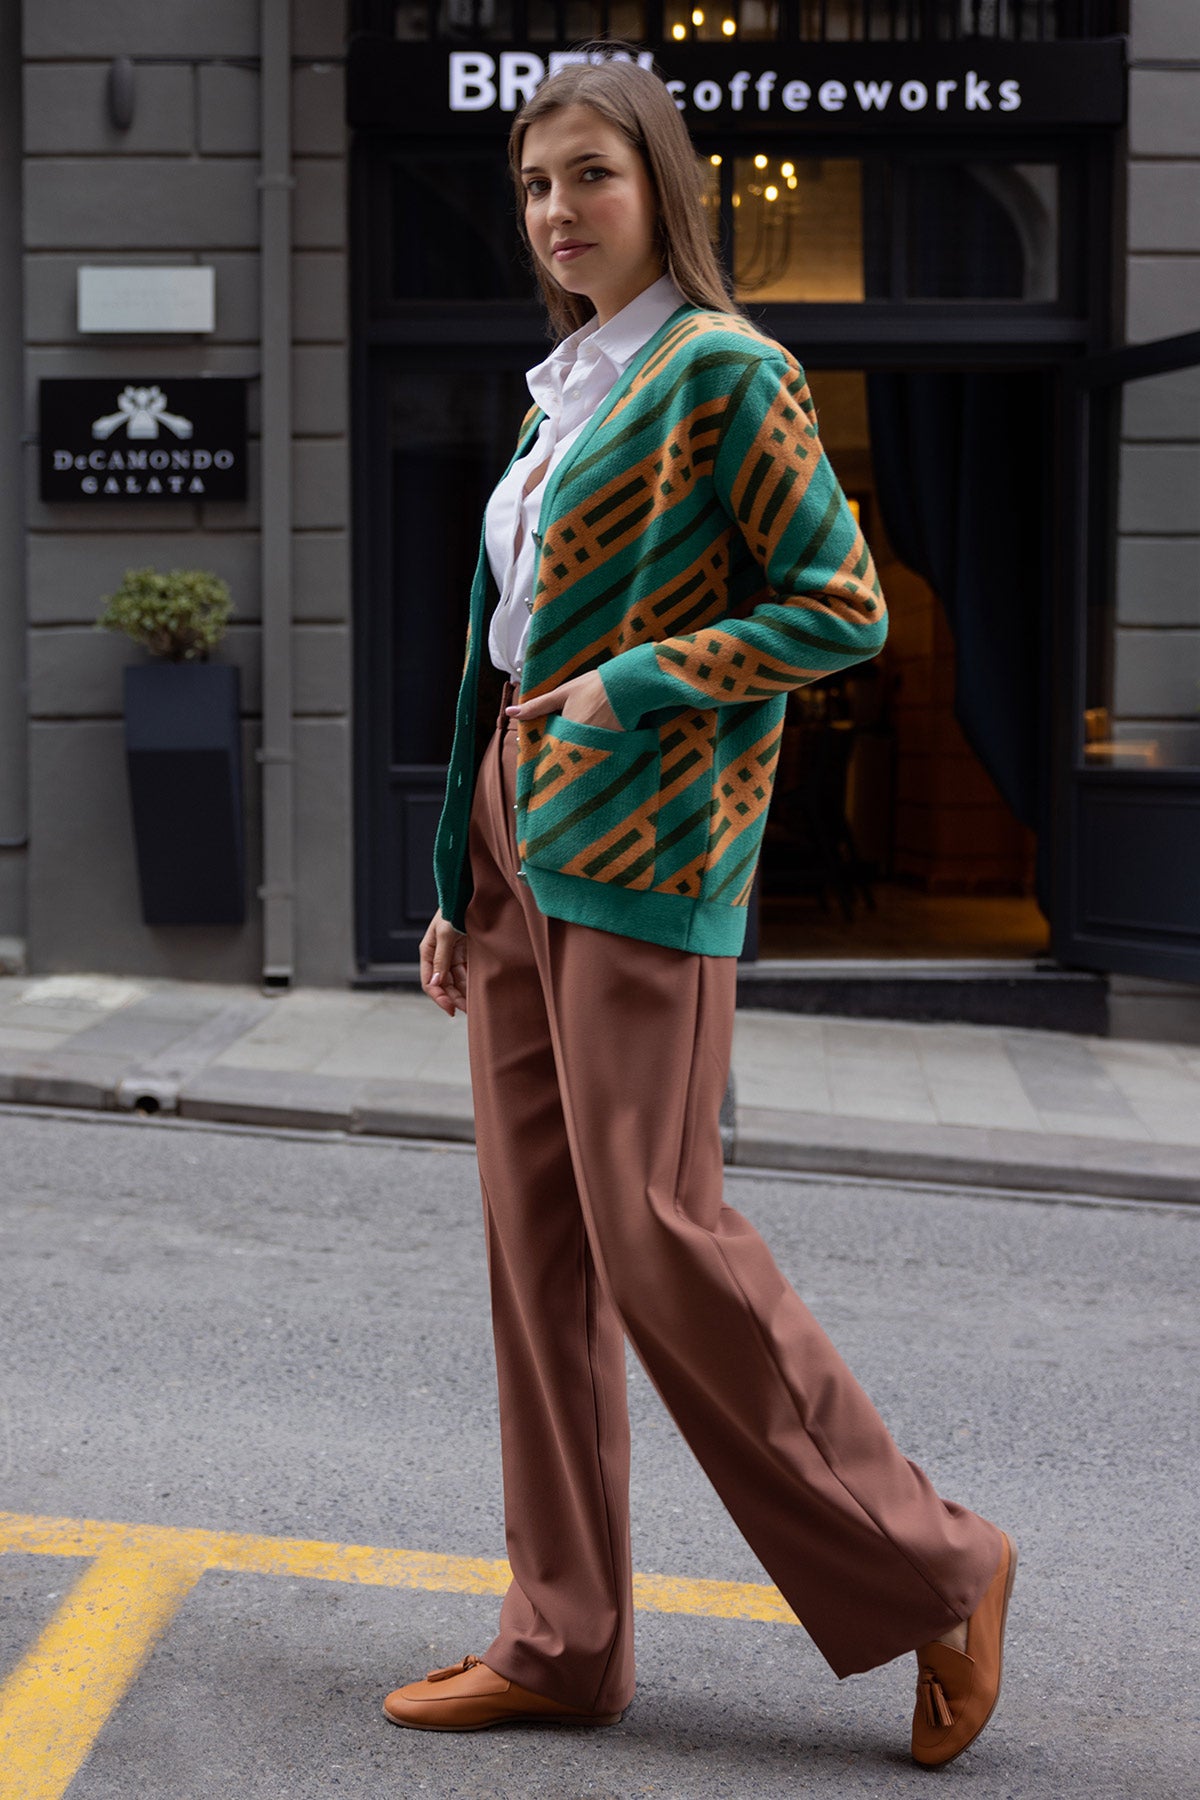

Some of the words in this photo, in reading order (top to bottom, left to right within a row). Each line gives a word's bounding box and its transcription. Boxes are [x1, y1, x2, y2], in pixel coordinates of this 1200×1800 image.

[449, 51, 654, 112] BR
[53, 449, 235, 471] DeCAMONDO
[80, 475, 205, 494] GALATA
